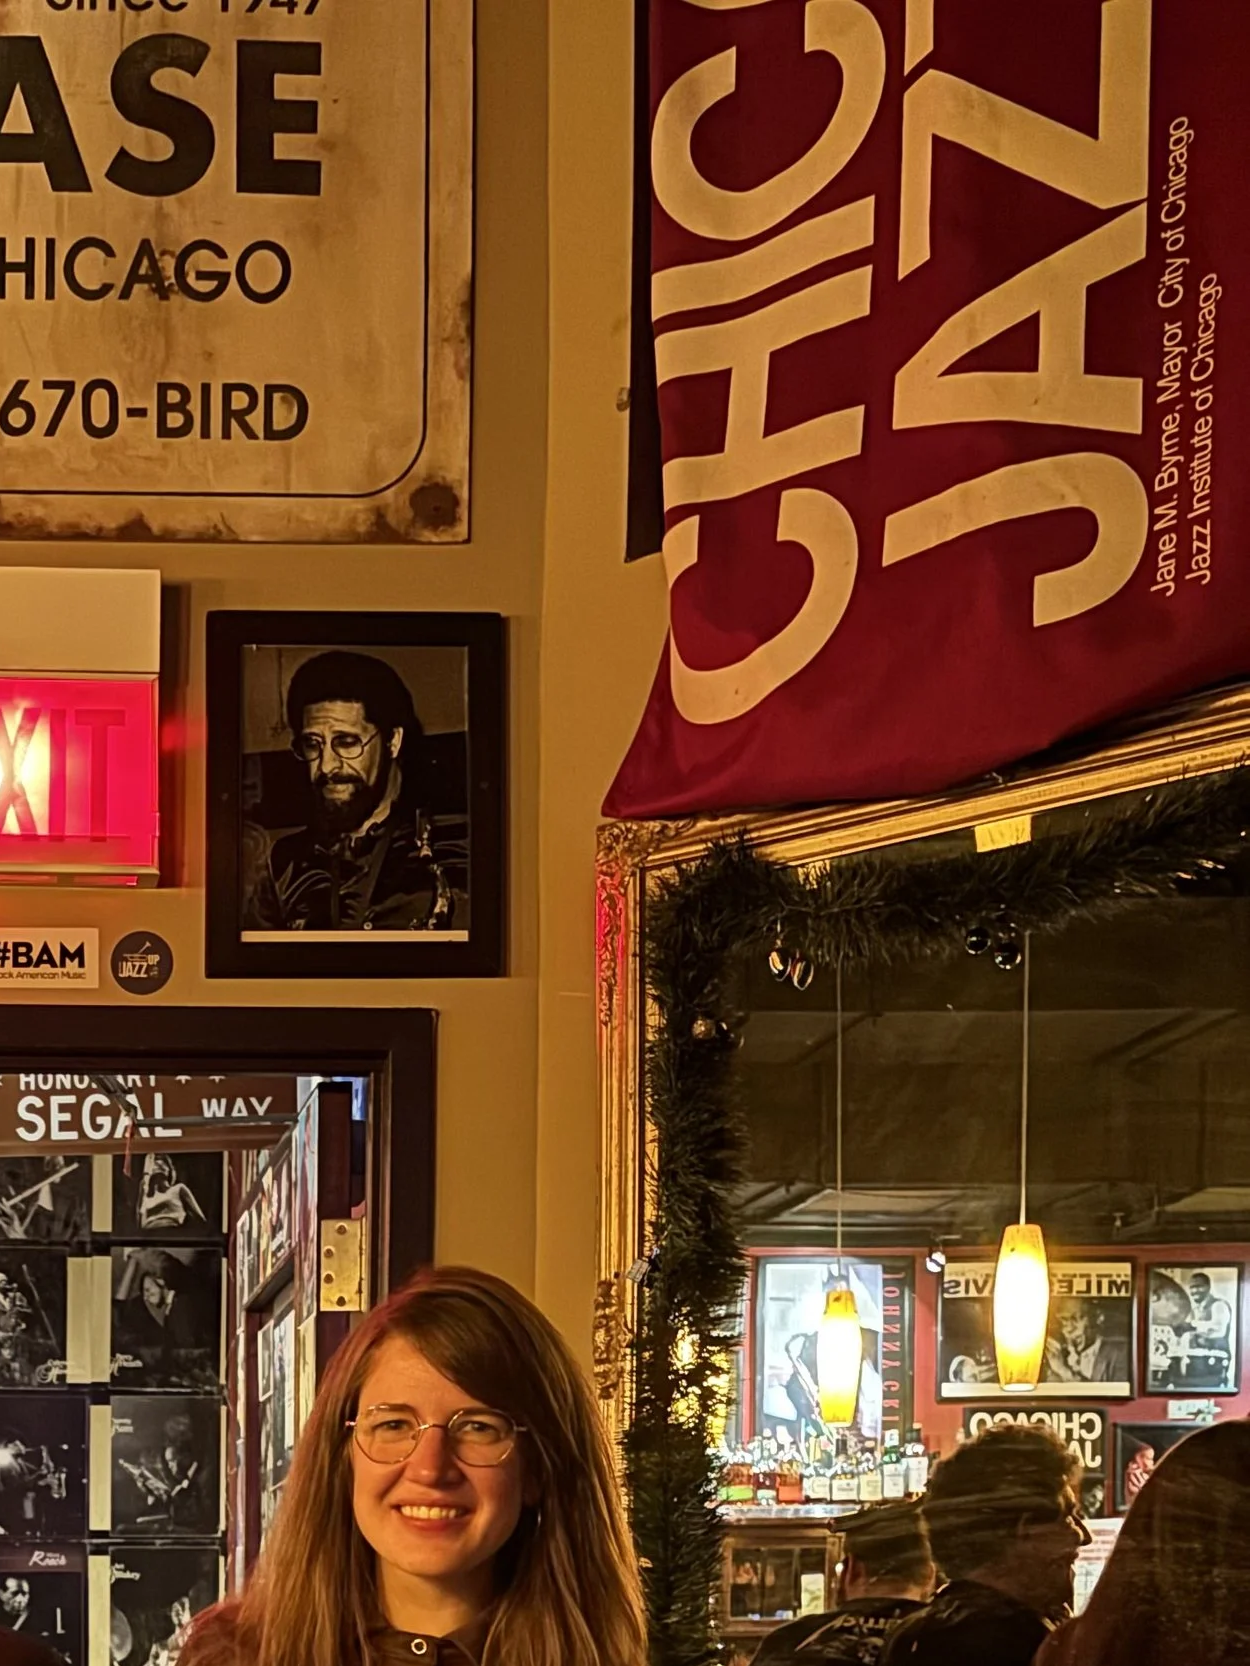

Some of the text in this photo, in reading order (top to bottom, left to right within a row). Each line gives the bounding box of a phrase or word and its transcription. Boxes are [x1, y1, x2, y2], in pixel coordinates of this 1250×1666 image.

[650, 0, 886, 725] CHIC
[1150, 115, 1196, 597] Jane M. Byrne, Mayor City of Chicago
[1185, 272, 1223, 586] Jazz Institute of Chicago
[15, 971, 60, 979] American
[61, 971, 86, 979] Music
[118, 961, 149, 978] JAZZ
[15, 1092, 183, 1141] SEGAL
[201, 1096, 273, 1119] WAY
